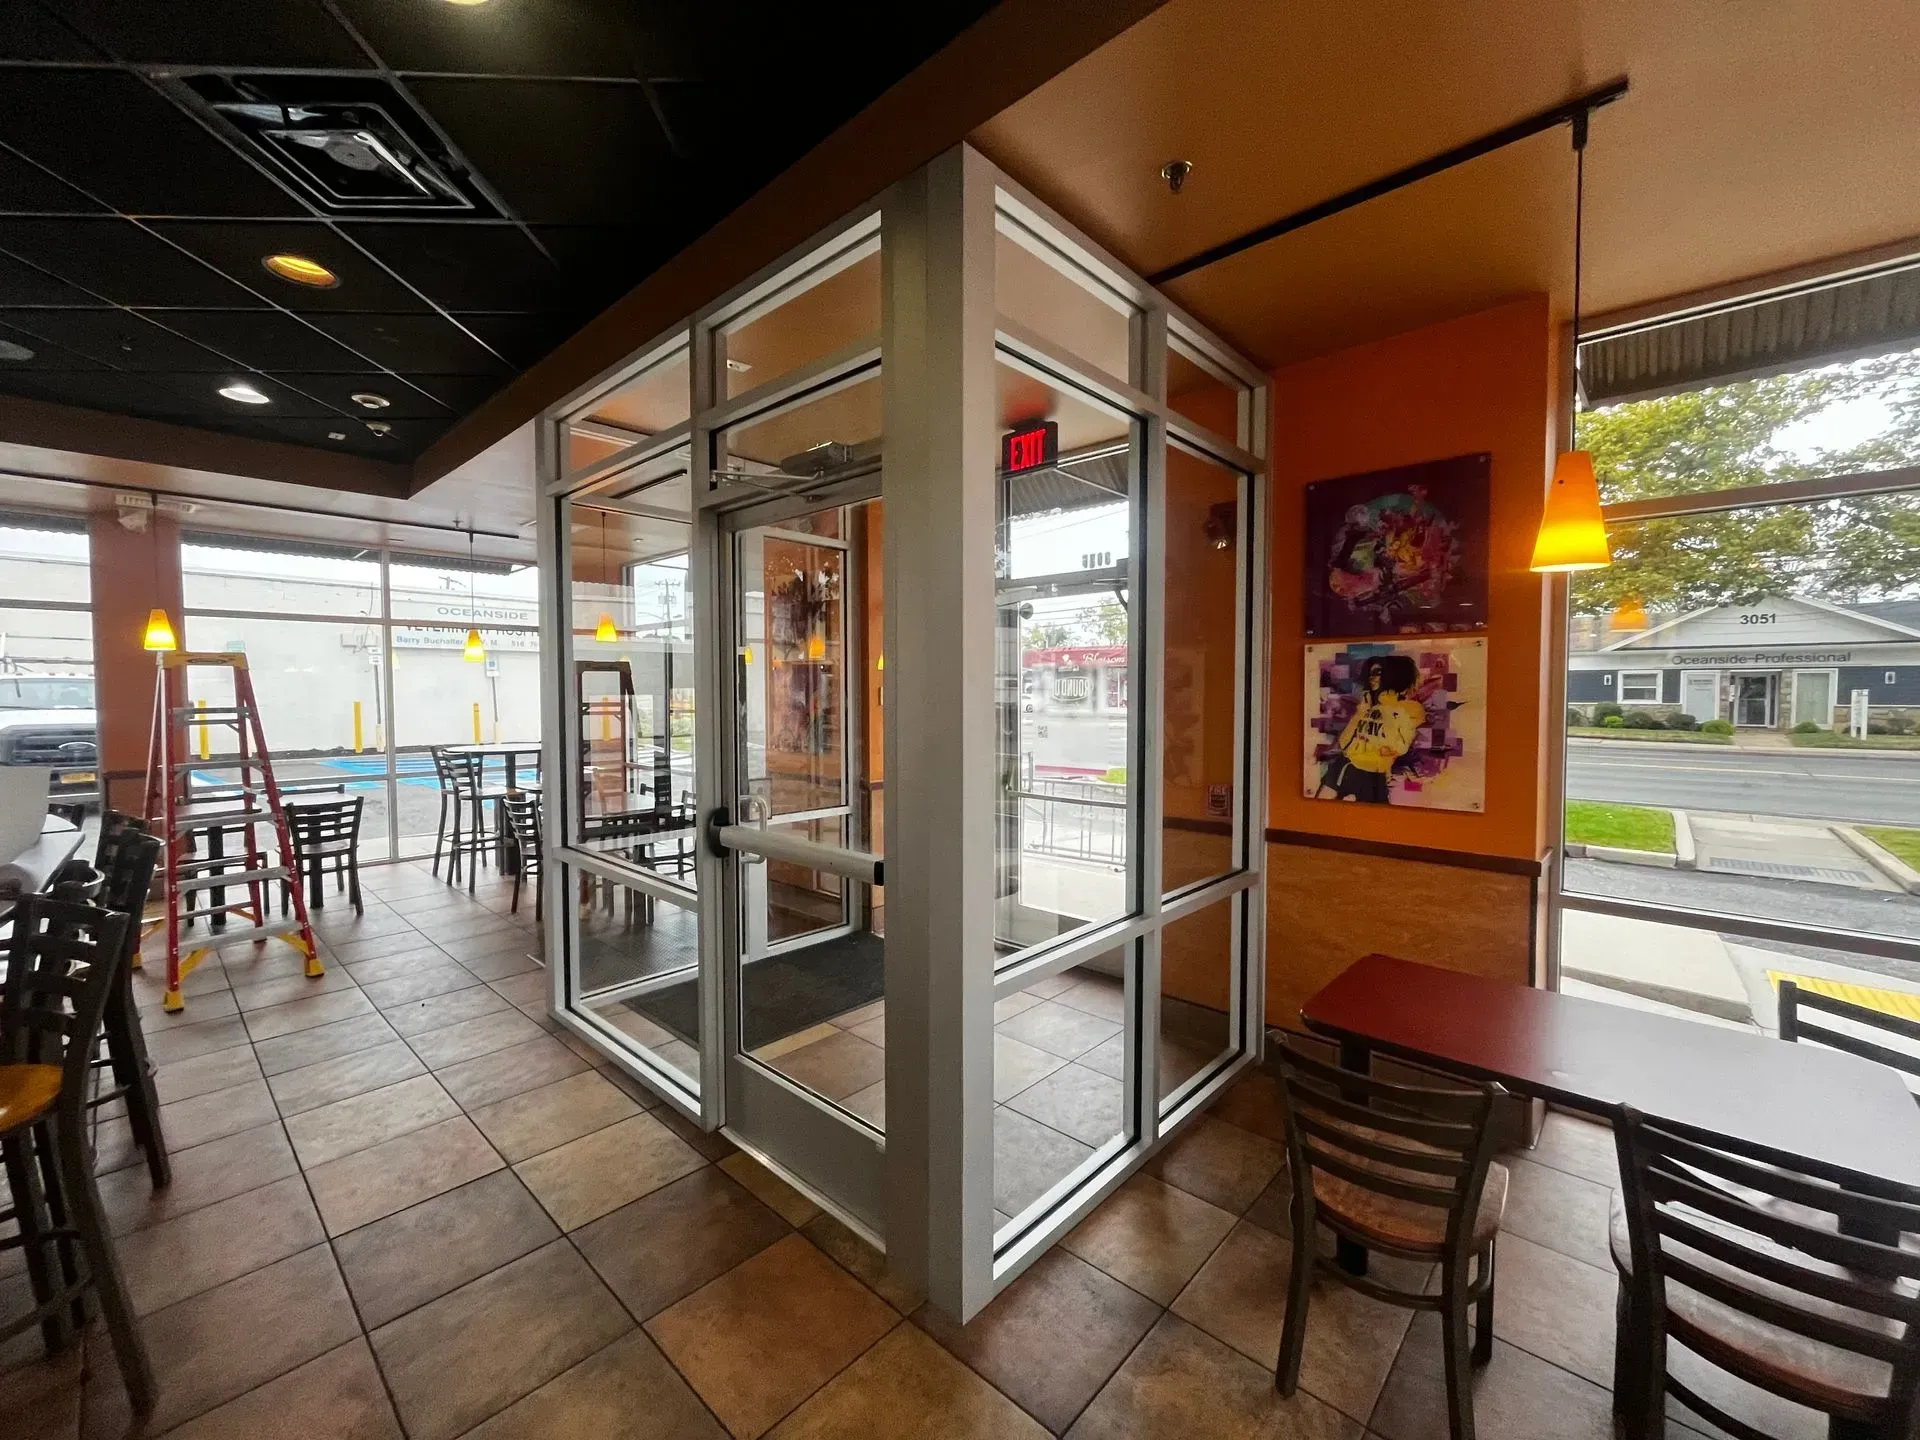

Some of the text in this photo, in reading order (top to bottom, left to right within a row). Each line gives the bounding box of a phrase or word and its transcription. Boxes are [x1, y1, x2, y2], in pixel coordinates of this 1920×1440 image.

[1010, 428, 1046, 471] EXIT
[437, 607, 528, 620] OCEANSIDE
[1740, 613, 1777, 625] 3051
[396, 635, 420, 644] Barry
[1672, 652, 1852, 665] Oceanside Professional
